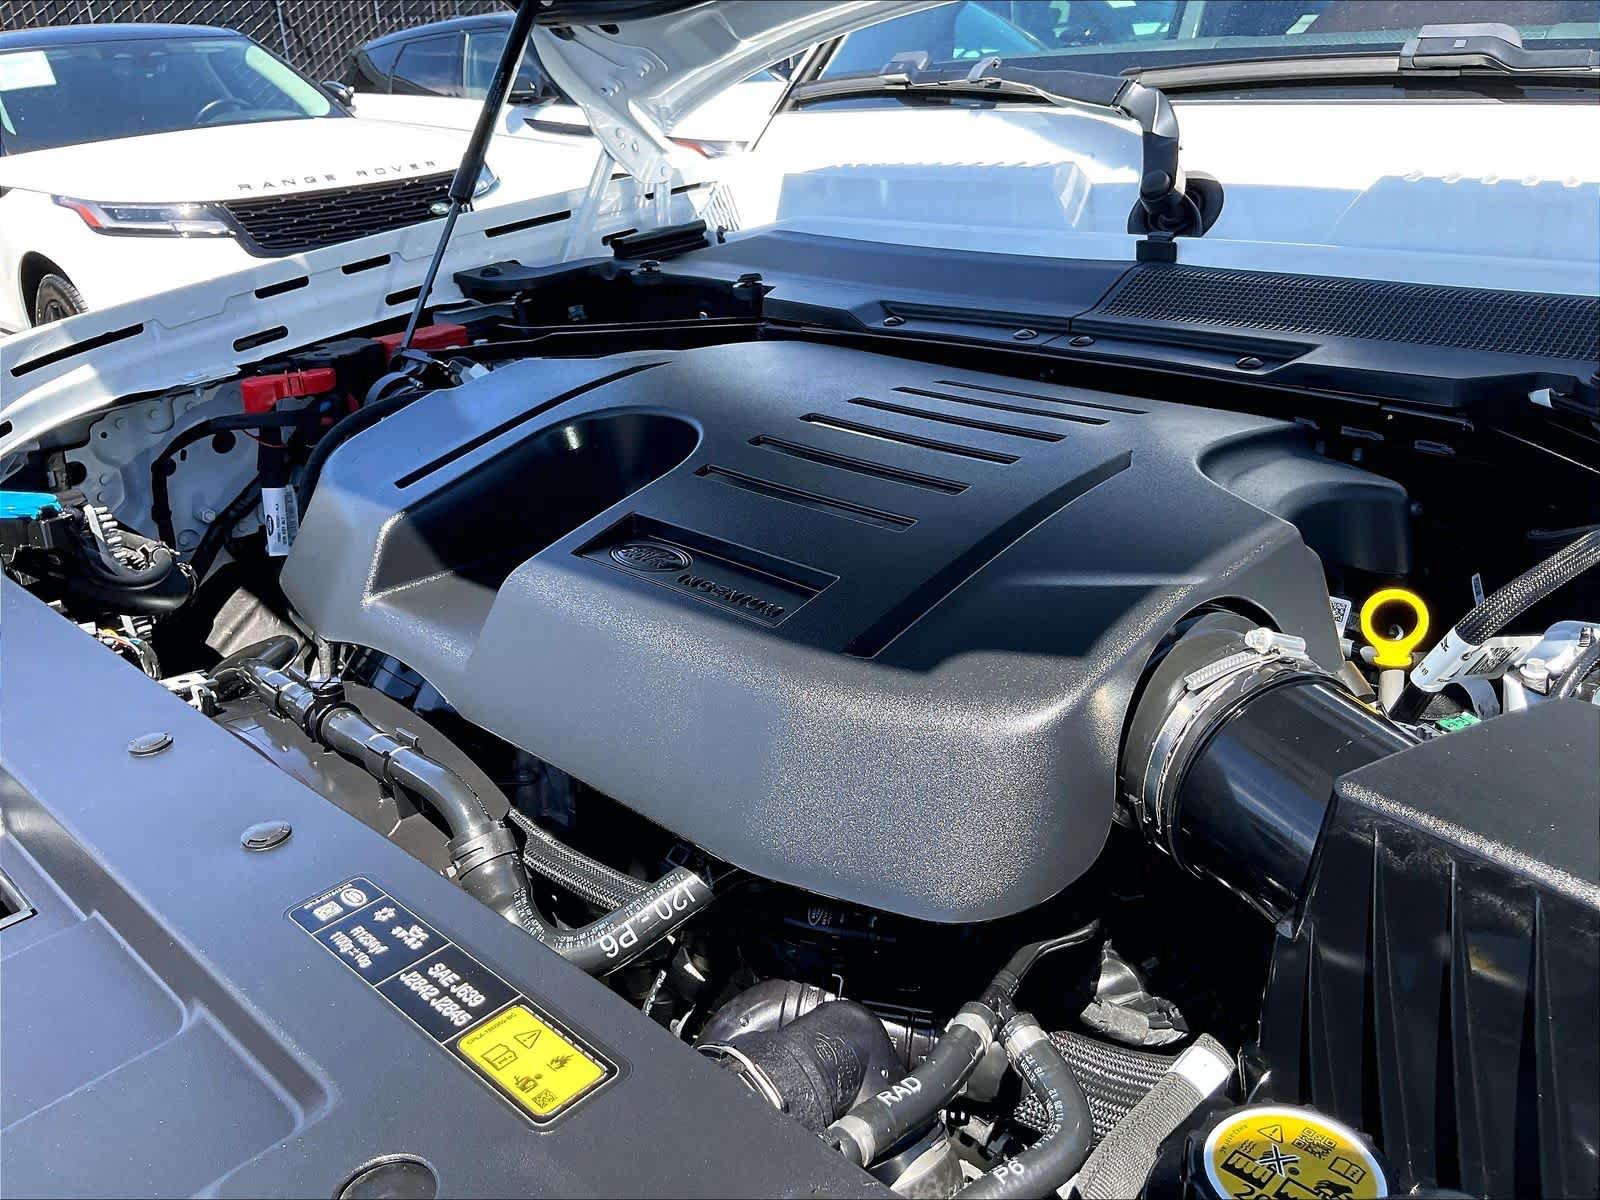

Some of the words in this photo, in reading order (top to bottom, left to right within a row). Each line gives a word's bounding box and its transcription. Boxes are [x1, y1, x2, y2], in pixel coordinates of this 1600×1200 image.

[237, 173, 337, 191] RANGE
[356, 160, 436, 177] ROVER
[599, 921, 639, 958] P6
[400, 970, 440, 1001] J2842
[430, 995, 473, 1027] J2845
[428, 962, 461, 987] SAE
[450, 982, 486, 1007] J639
[876, 1076, 922, 1108] RAD
[992, 1160, 1025, 1185] P6
